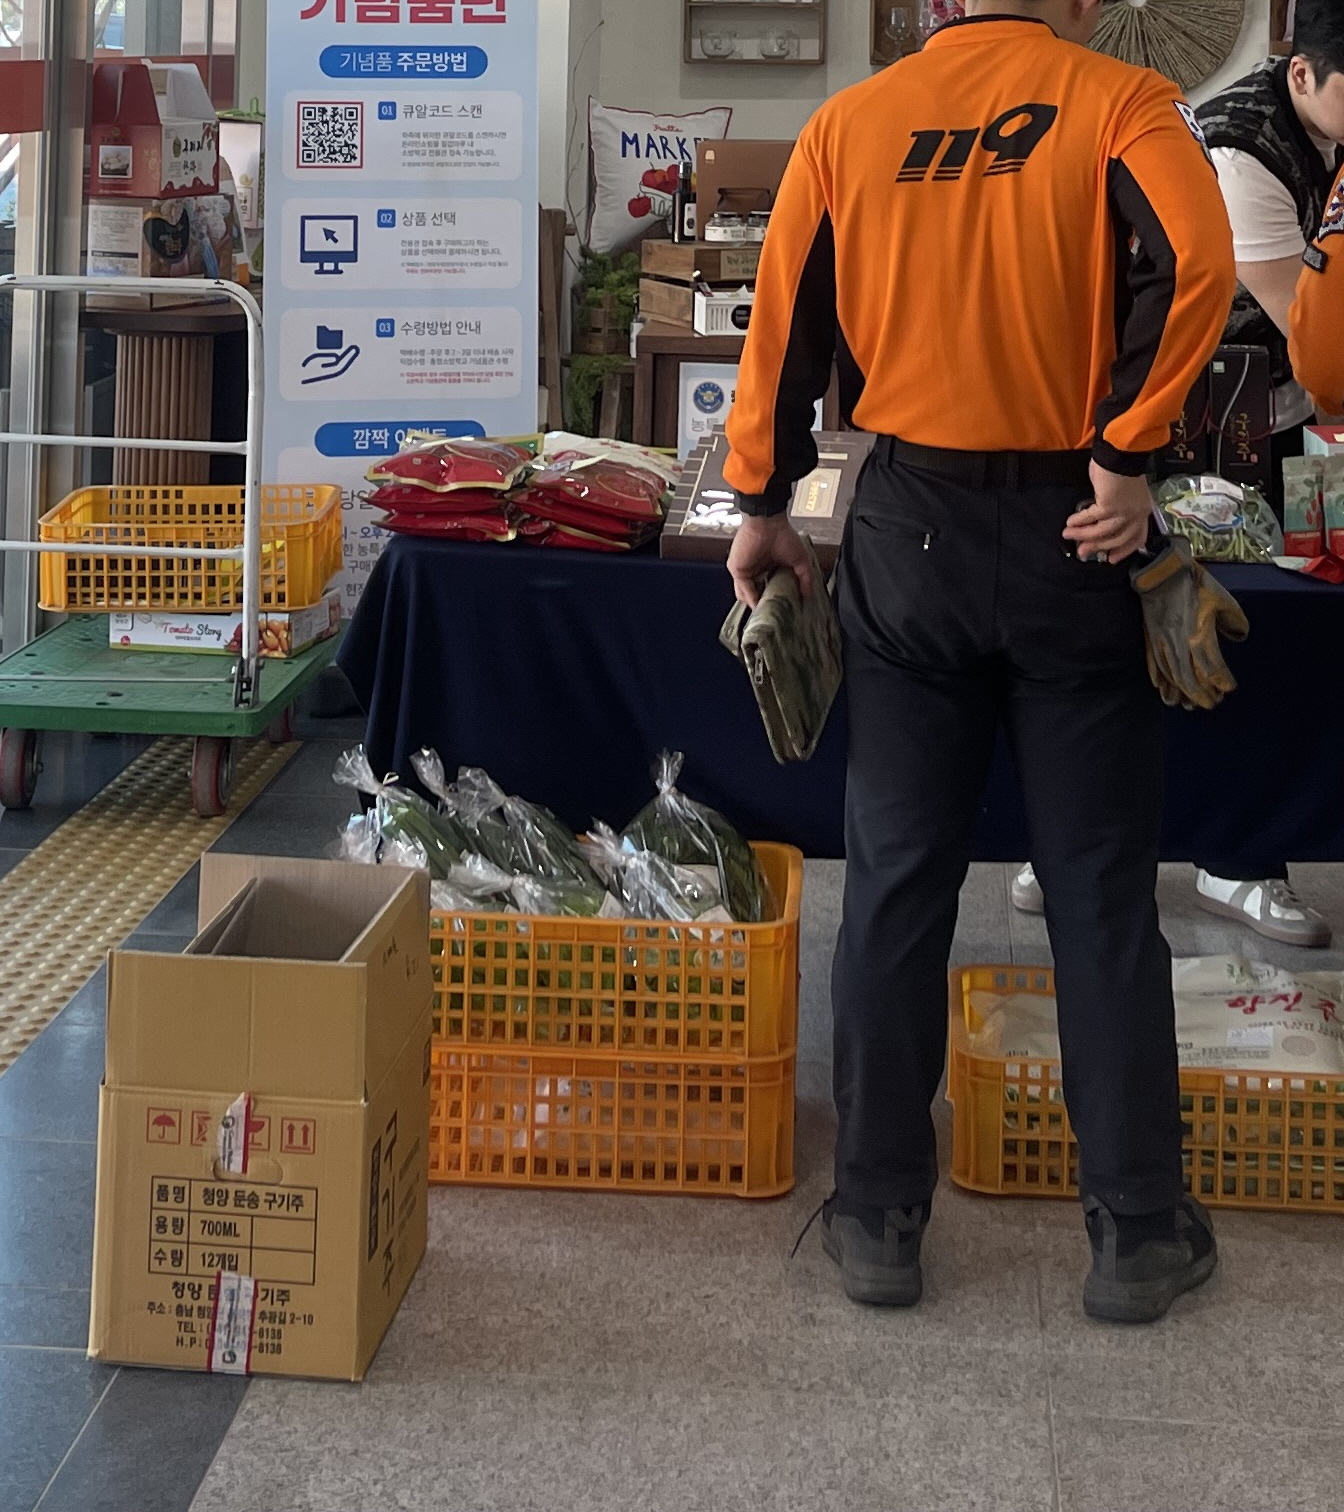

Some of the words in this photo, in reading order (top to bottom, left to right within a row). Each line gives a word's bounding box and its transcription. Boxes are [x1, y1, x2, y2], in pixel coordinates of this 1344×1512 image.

[339, 52, 393, 73] 기념품
[396, 52, 467, 73] 주문방법
[381, 105, 393, 116] 01
[402, 104, 454, 119] 큐알코드
[457, 104, 483, 119] 스캔
[621, 130, 710, 162] MARK
[895, 102, 1058, 183] 119
[380, 213, 393, 224] 02
[401, 211, 427, 227] 상품
[430, 211, 456, 227] 선택
[379, 322, 391, 333] 03
[400, 320, 452, 336] 수령방법
[455, 320, 481, 335] 안내
[353, 427, 390, 450] 깜짝
[358, 543, 387, 557] 농특
[203, 1187, 230, 1207] 청양
[234, 1190, 260, 1209] 둔송
[264, 1192, 305, 1213] 구기주
[200, 1219, 240, 1238] 700ML
[201, 1252, 239, 1271] 12개입
[172, 1281, 203, 1300] 청양
[256, 1287, 291, 1307] 기주
[289, 1312, 314, 1326] 2-10
